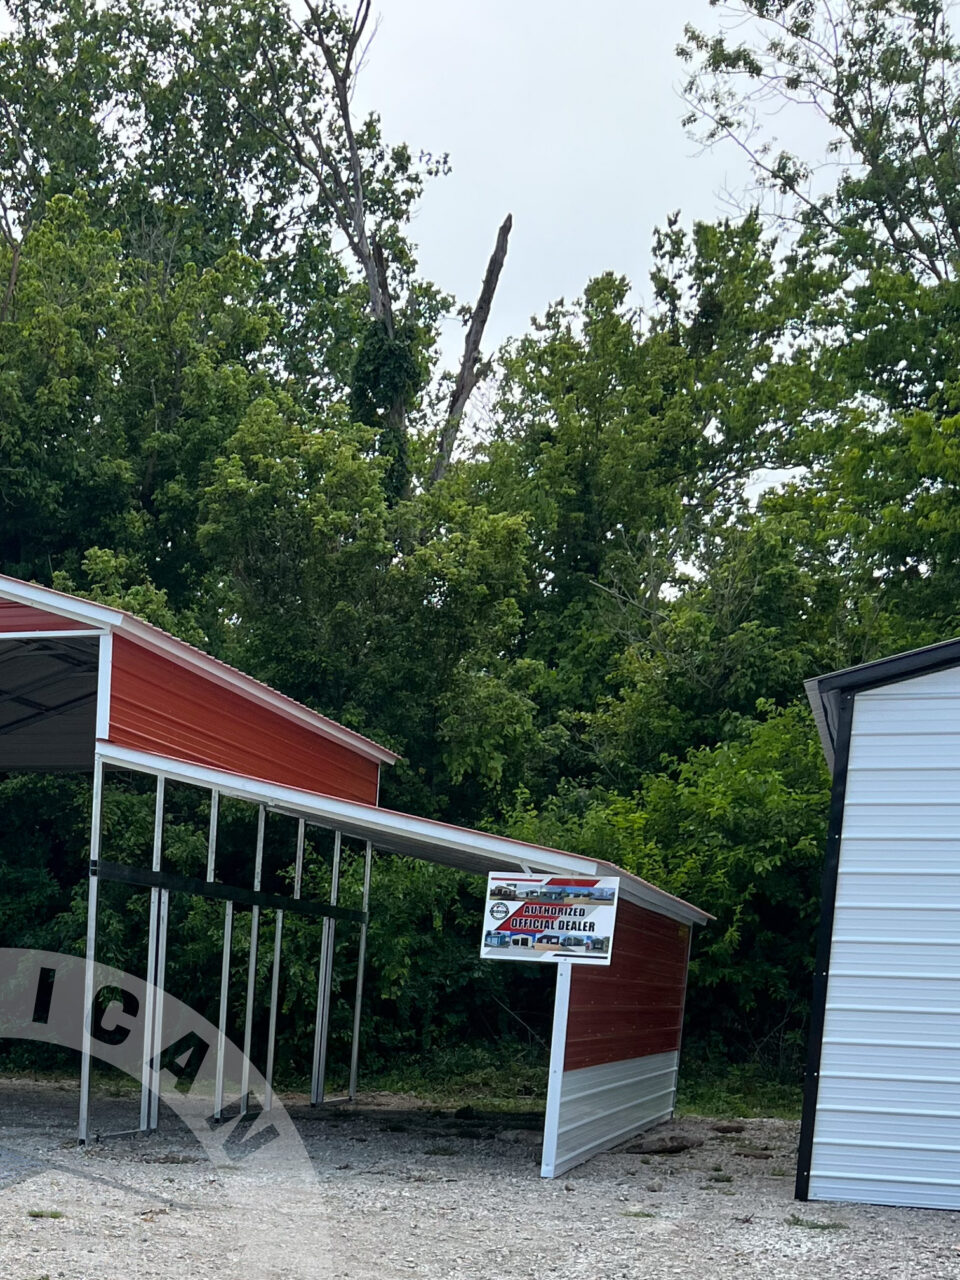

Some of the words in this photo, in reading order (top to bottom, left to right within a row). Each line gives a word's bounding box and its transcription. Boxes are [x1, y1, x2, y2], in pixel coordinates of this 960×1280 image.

[523, 906, 586, 917] AUTHORIZED
[511, 918, 555, 930] OFFICIAL
[558, 920, 596, 932] DEALER
